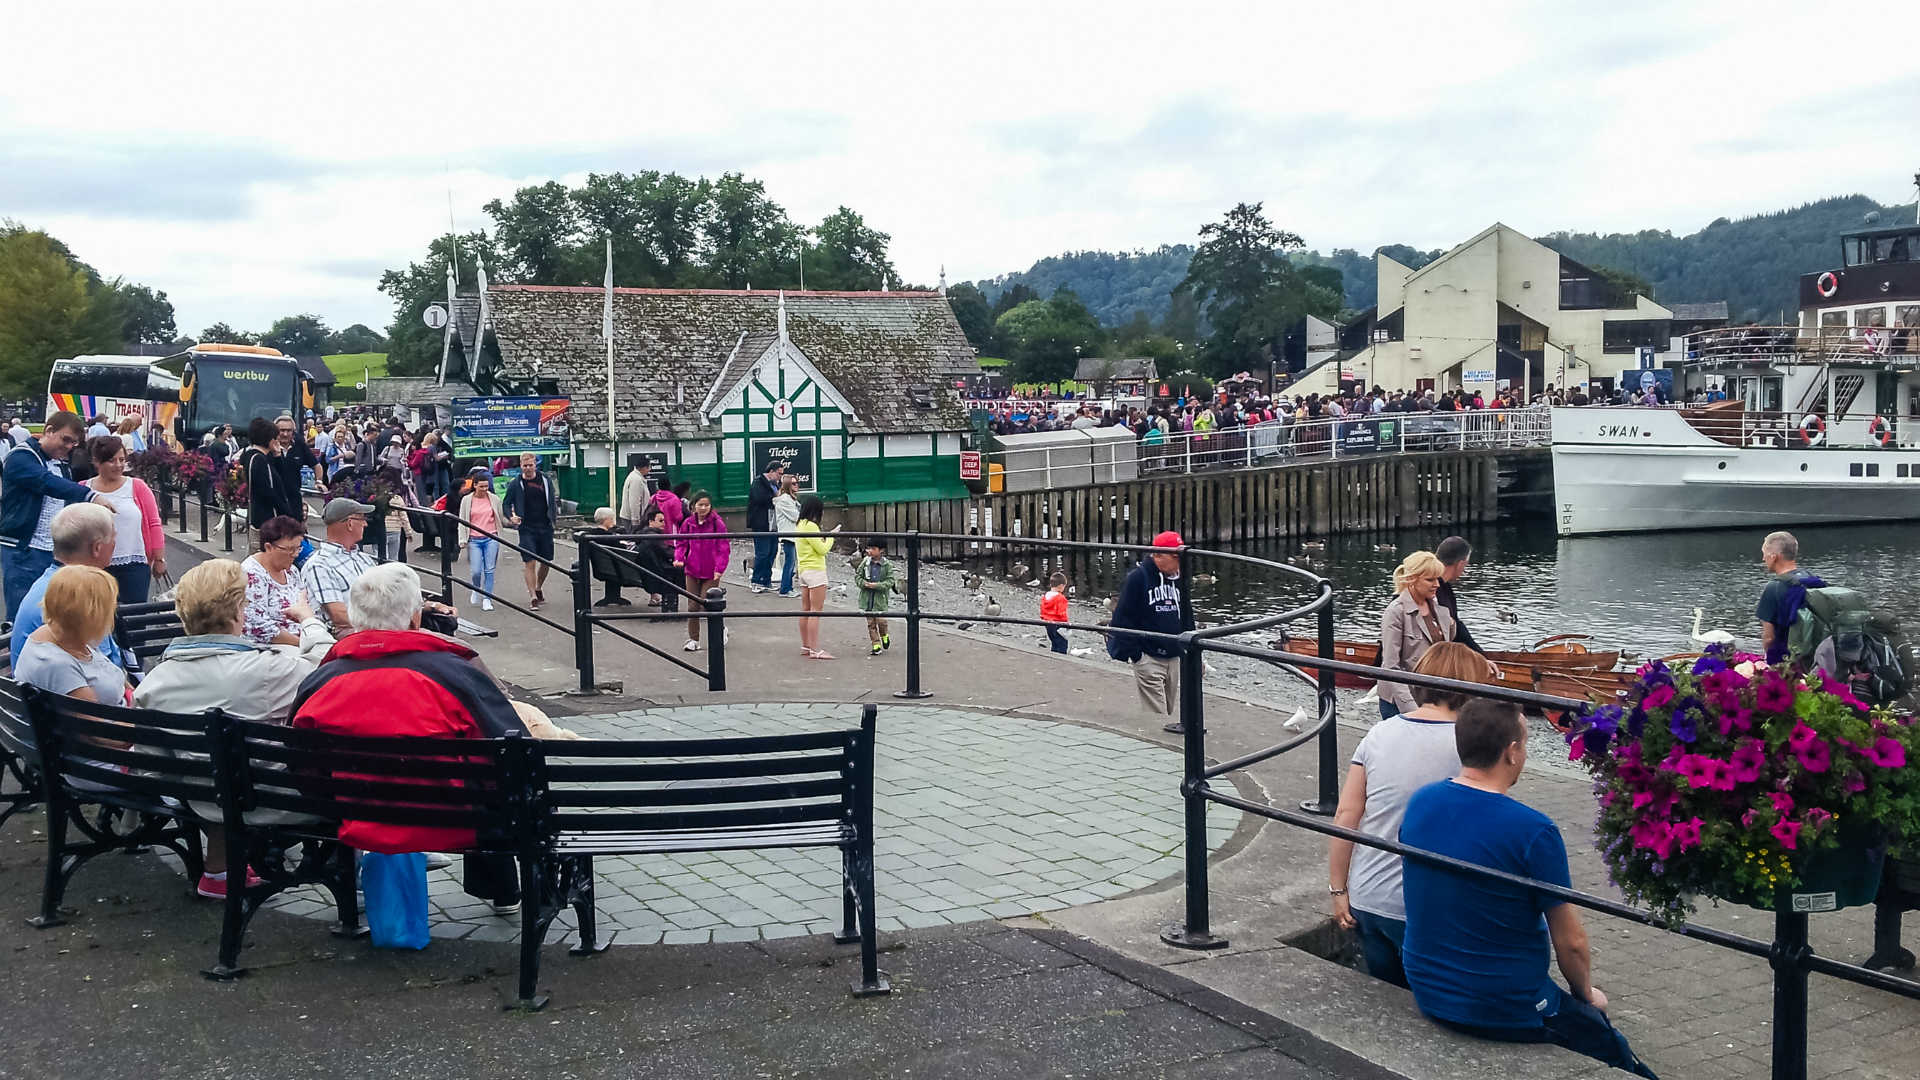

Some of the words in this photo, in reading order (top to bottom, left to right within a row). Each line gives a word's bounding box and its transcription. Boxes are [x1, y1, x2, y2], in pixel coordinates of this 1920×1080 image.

[431, 310, 440, 326] 1
[1645, 355, 1650, 368] 1
[223, 370, 270, 381] westbus
[779, 404, 785, 415] 1
[1598, 425, 1639, 438] SWAN
[768, 446, 799, 459] Tickets
